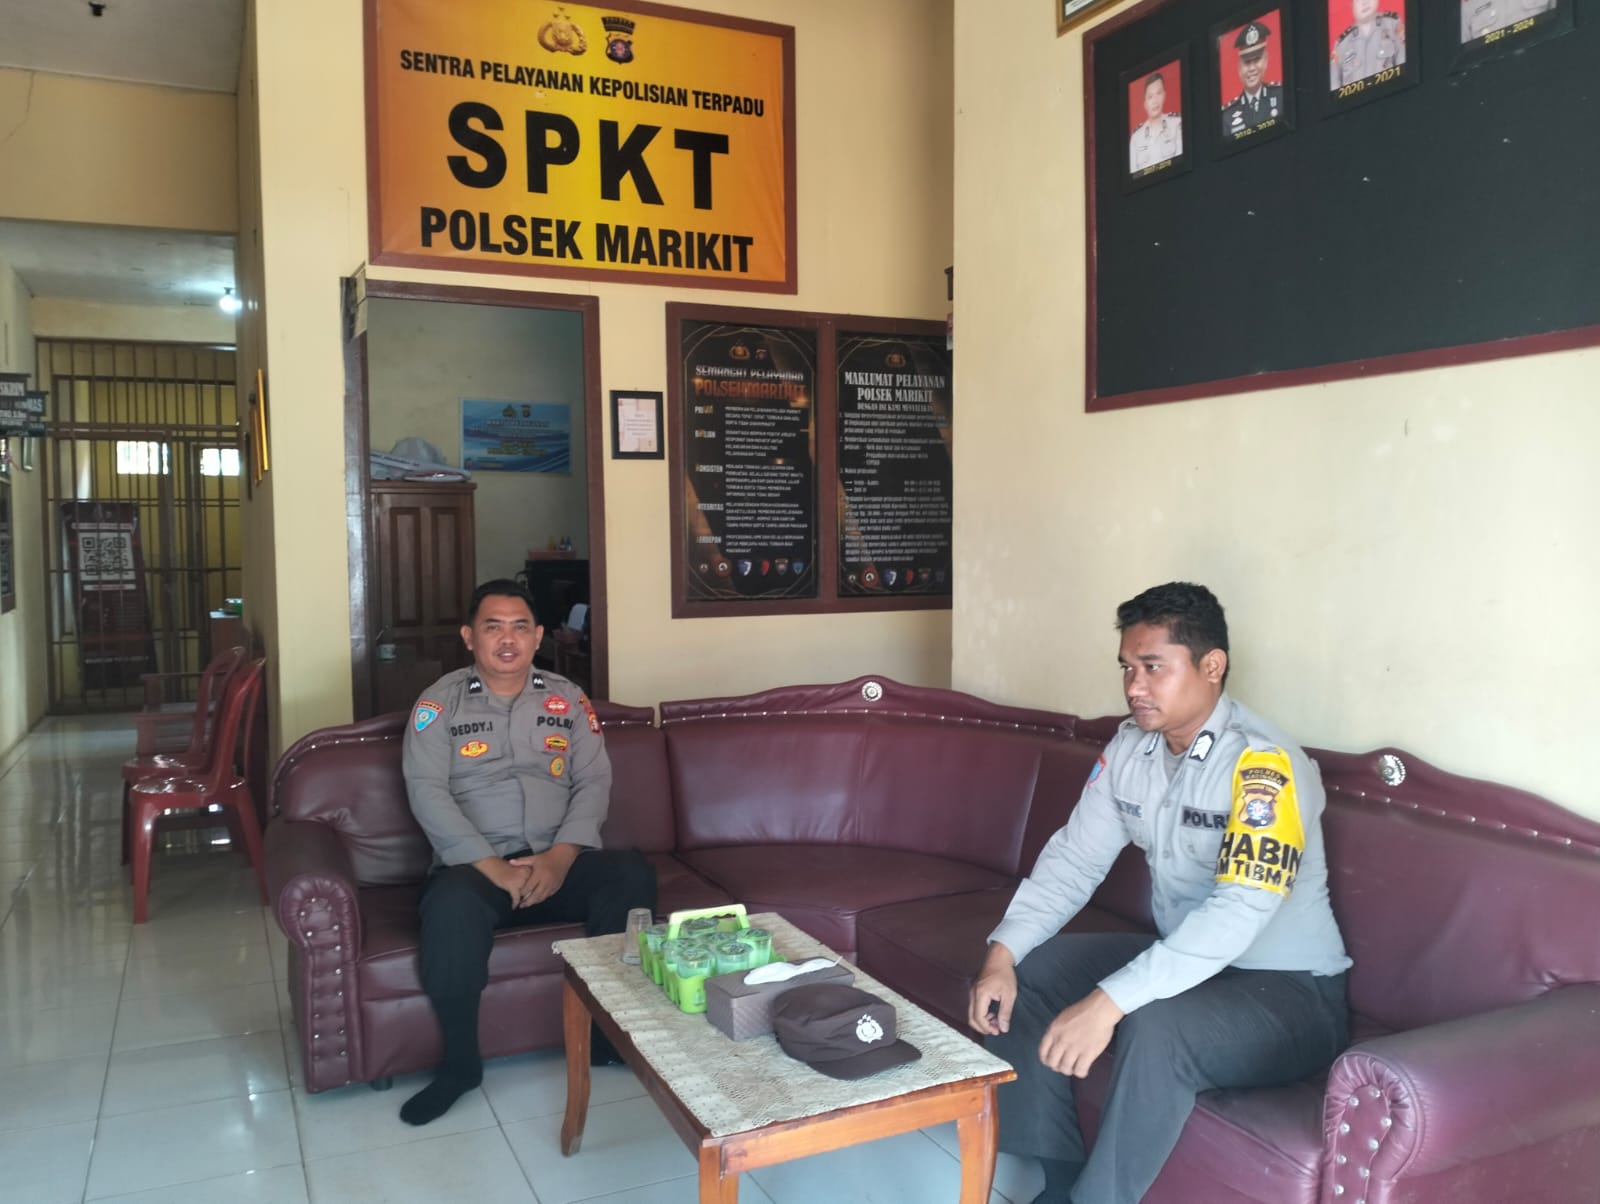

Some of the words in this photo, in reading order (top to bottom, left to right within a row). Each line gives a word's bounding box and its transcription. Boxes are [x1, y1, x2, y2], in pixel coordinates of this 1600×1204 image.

[400, 49, 475, 79] SENTRA
[480, 62, 584, 93] PELAYANAN
[589, 77, 688, 107] KEPOLISIAN
[692, 90, 764, 117] TERPADU
[1338, 80, 1365, 98] 2020
[1375, 67, 1401, 86] 2021
[446, 101, 729, 210] SPKT
[420, 206, 583, 260] POLSEK
[596, 222, 753, 274] MARIKIT
[844, 371, 893, 386] MAKLUMAT
[896, 374, 945, 388] PELAYANAN
[857, 387, 892, 401] POLSEK
[895, 389, 933, 402] MARIKIT
[537, 716, 573, 730] POLRI
